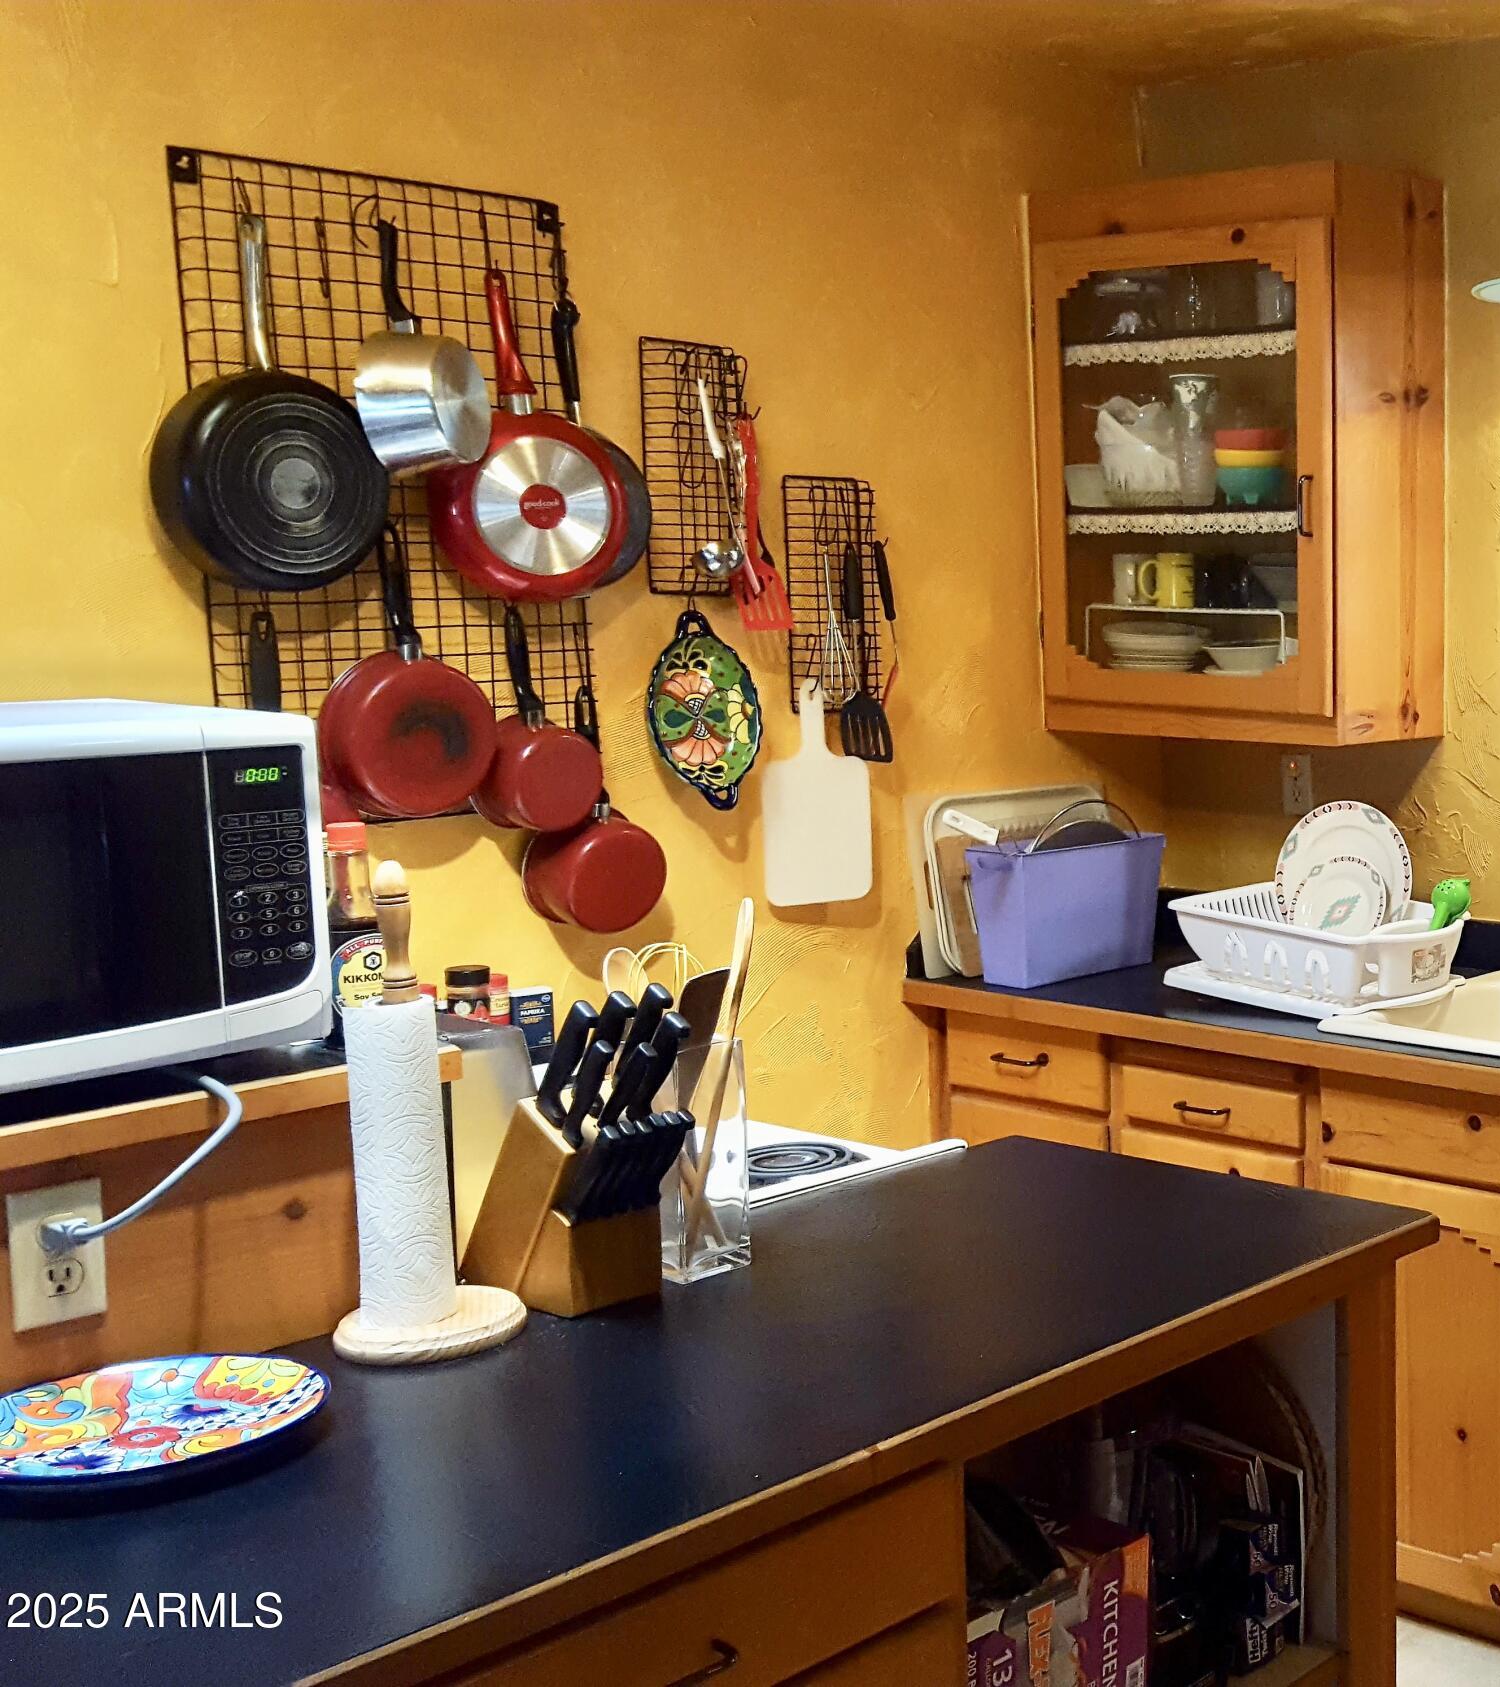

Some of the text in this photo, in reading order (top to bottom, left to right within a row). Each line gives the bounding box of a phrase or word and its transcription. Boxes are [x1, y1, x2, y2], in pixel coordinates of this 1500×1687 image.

[343, 972, 384, 984] KIKKO
[967, 1651, 977, 1677] 200
[992, 1648, 1013, 1687] 13
